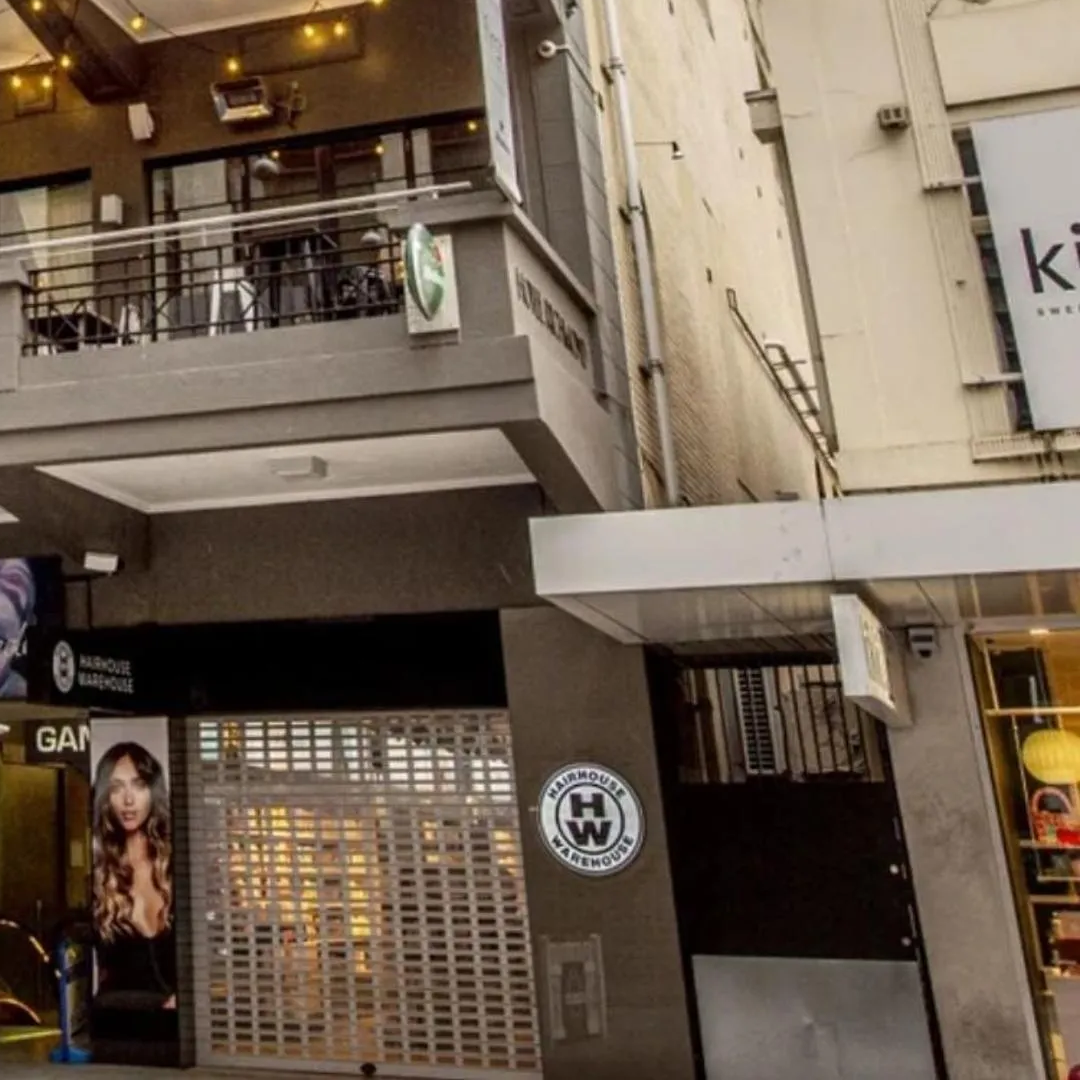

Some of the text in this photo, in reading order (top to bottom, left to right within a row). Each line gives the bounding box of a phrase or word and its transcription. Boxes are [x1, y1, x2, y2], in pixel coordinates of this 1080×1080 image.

[1036, 305, 1080, 316] SWE
[79, 654, 132, 676] HAIRHOUSE
[78, 671, 135, 695] WAREHOUSE
[546, 770, 625, 800] HAIRHOUSE
[570, 793, 606, 817] H
[566, 821, 613, 846] W
[552, 834, 634, 867] WAREHOUSE
